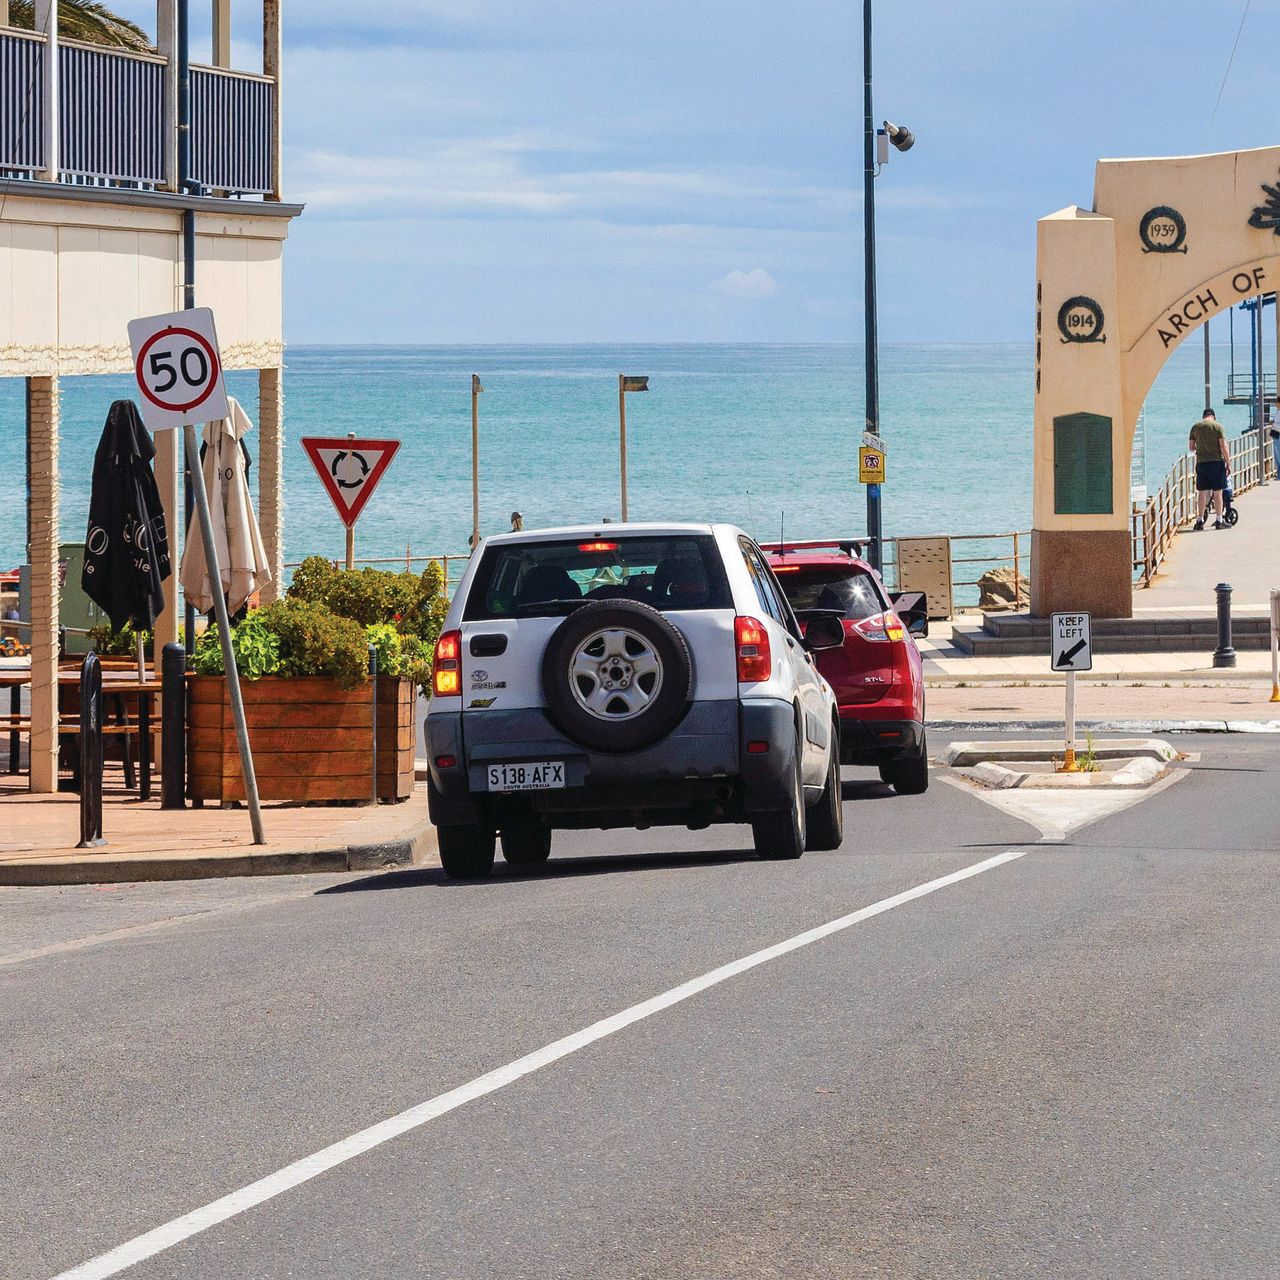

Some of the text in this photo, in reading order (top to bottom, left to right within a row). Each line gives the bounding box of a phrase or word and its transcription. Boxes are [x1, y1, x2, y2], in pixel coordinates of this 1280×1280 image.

[1150, 224, 1176, 237] 1939
[1155, 288, 1219, 349] ARCH
[1231, 266, 1266, 294] OF
[1067, 314, 1094, 328] 1914
[149, 346, 208, 393] 50
[1058, 616, 1084, 626] KEEP
[1060, 628, 1083, 638] LEFT
[472, 681, 507, 690] RAV4
